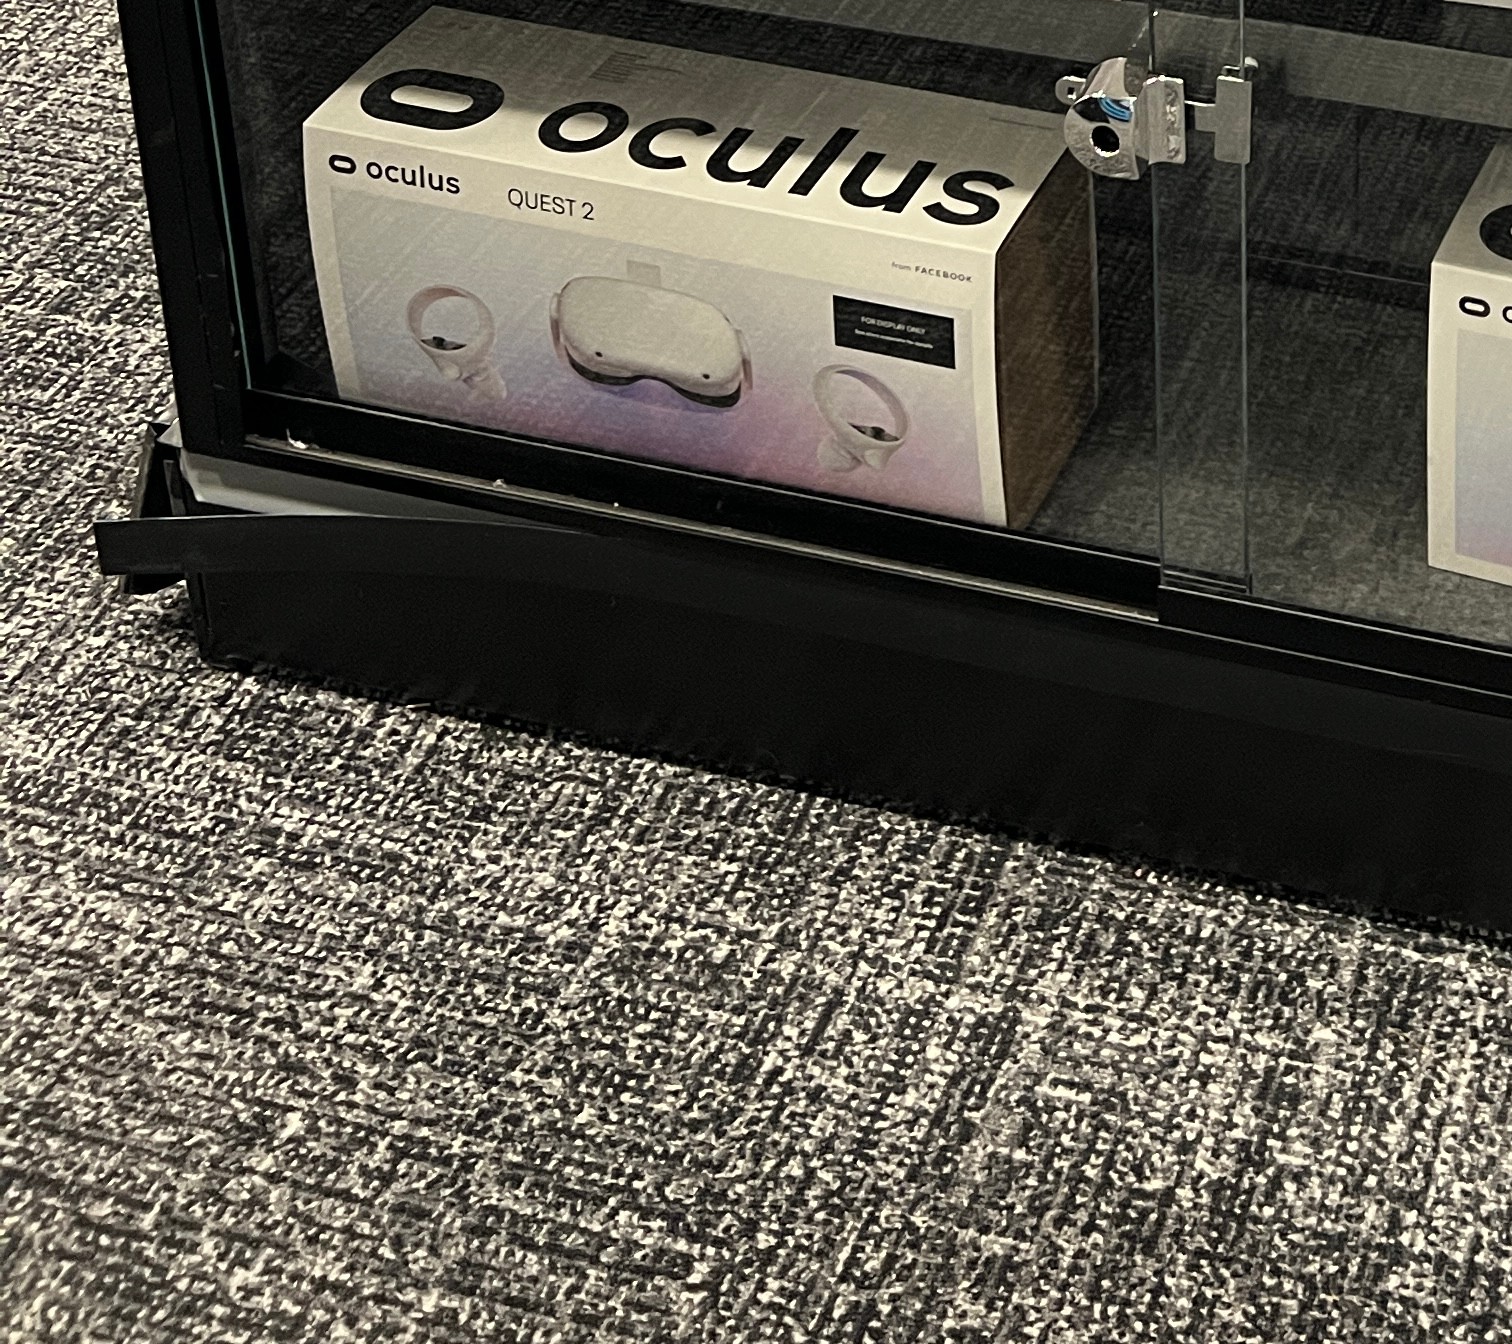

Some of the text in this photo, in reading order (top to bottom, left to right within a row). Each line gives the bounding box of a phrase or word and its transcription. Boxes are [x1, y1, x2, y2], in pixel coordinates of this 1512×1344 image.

[366, 161, 595, 220] oculus QUEST 2
[536, 99, 1015, 226] oculus
[915, 265, 973, 283] FACEBOOK
